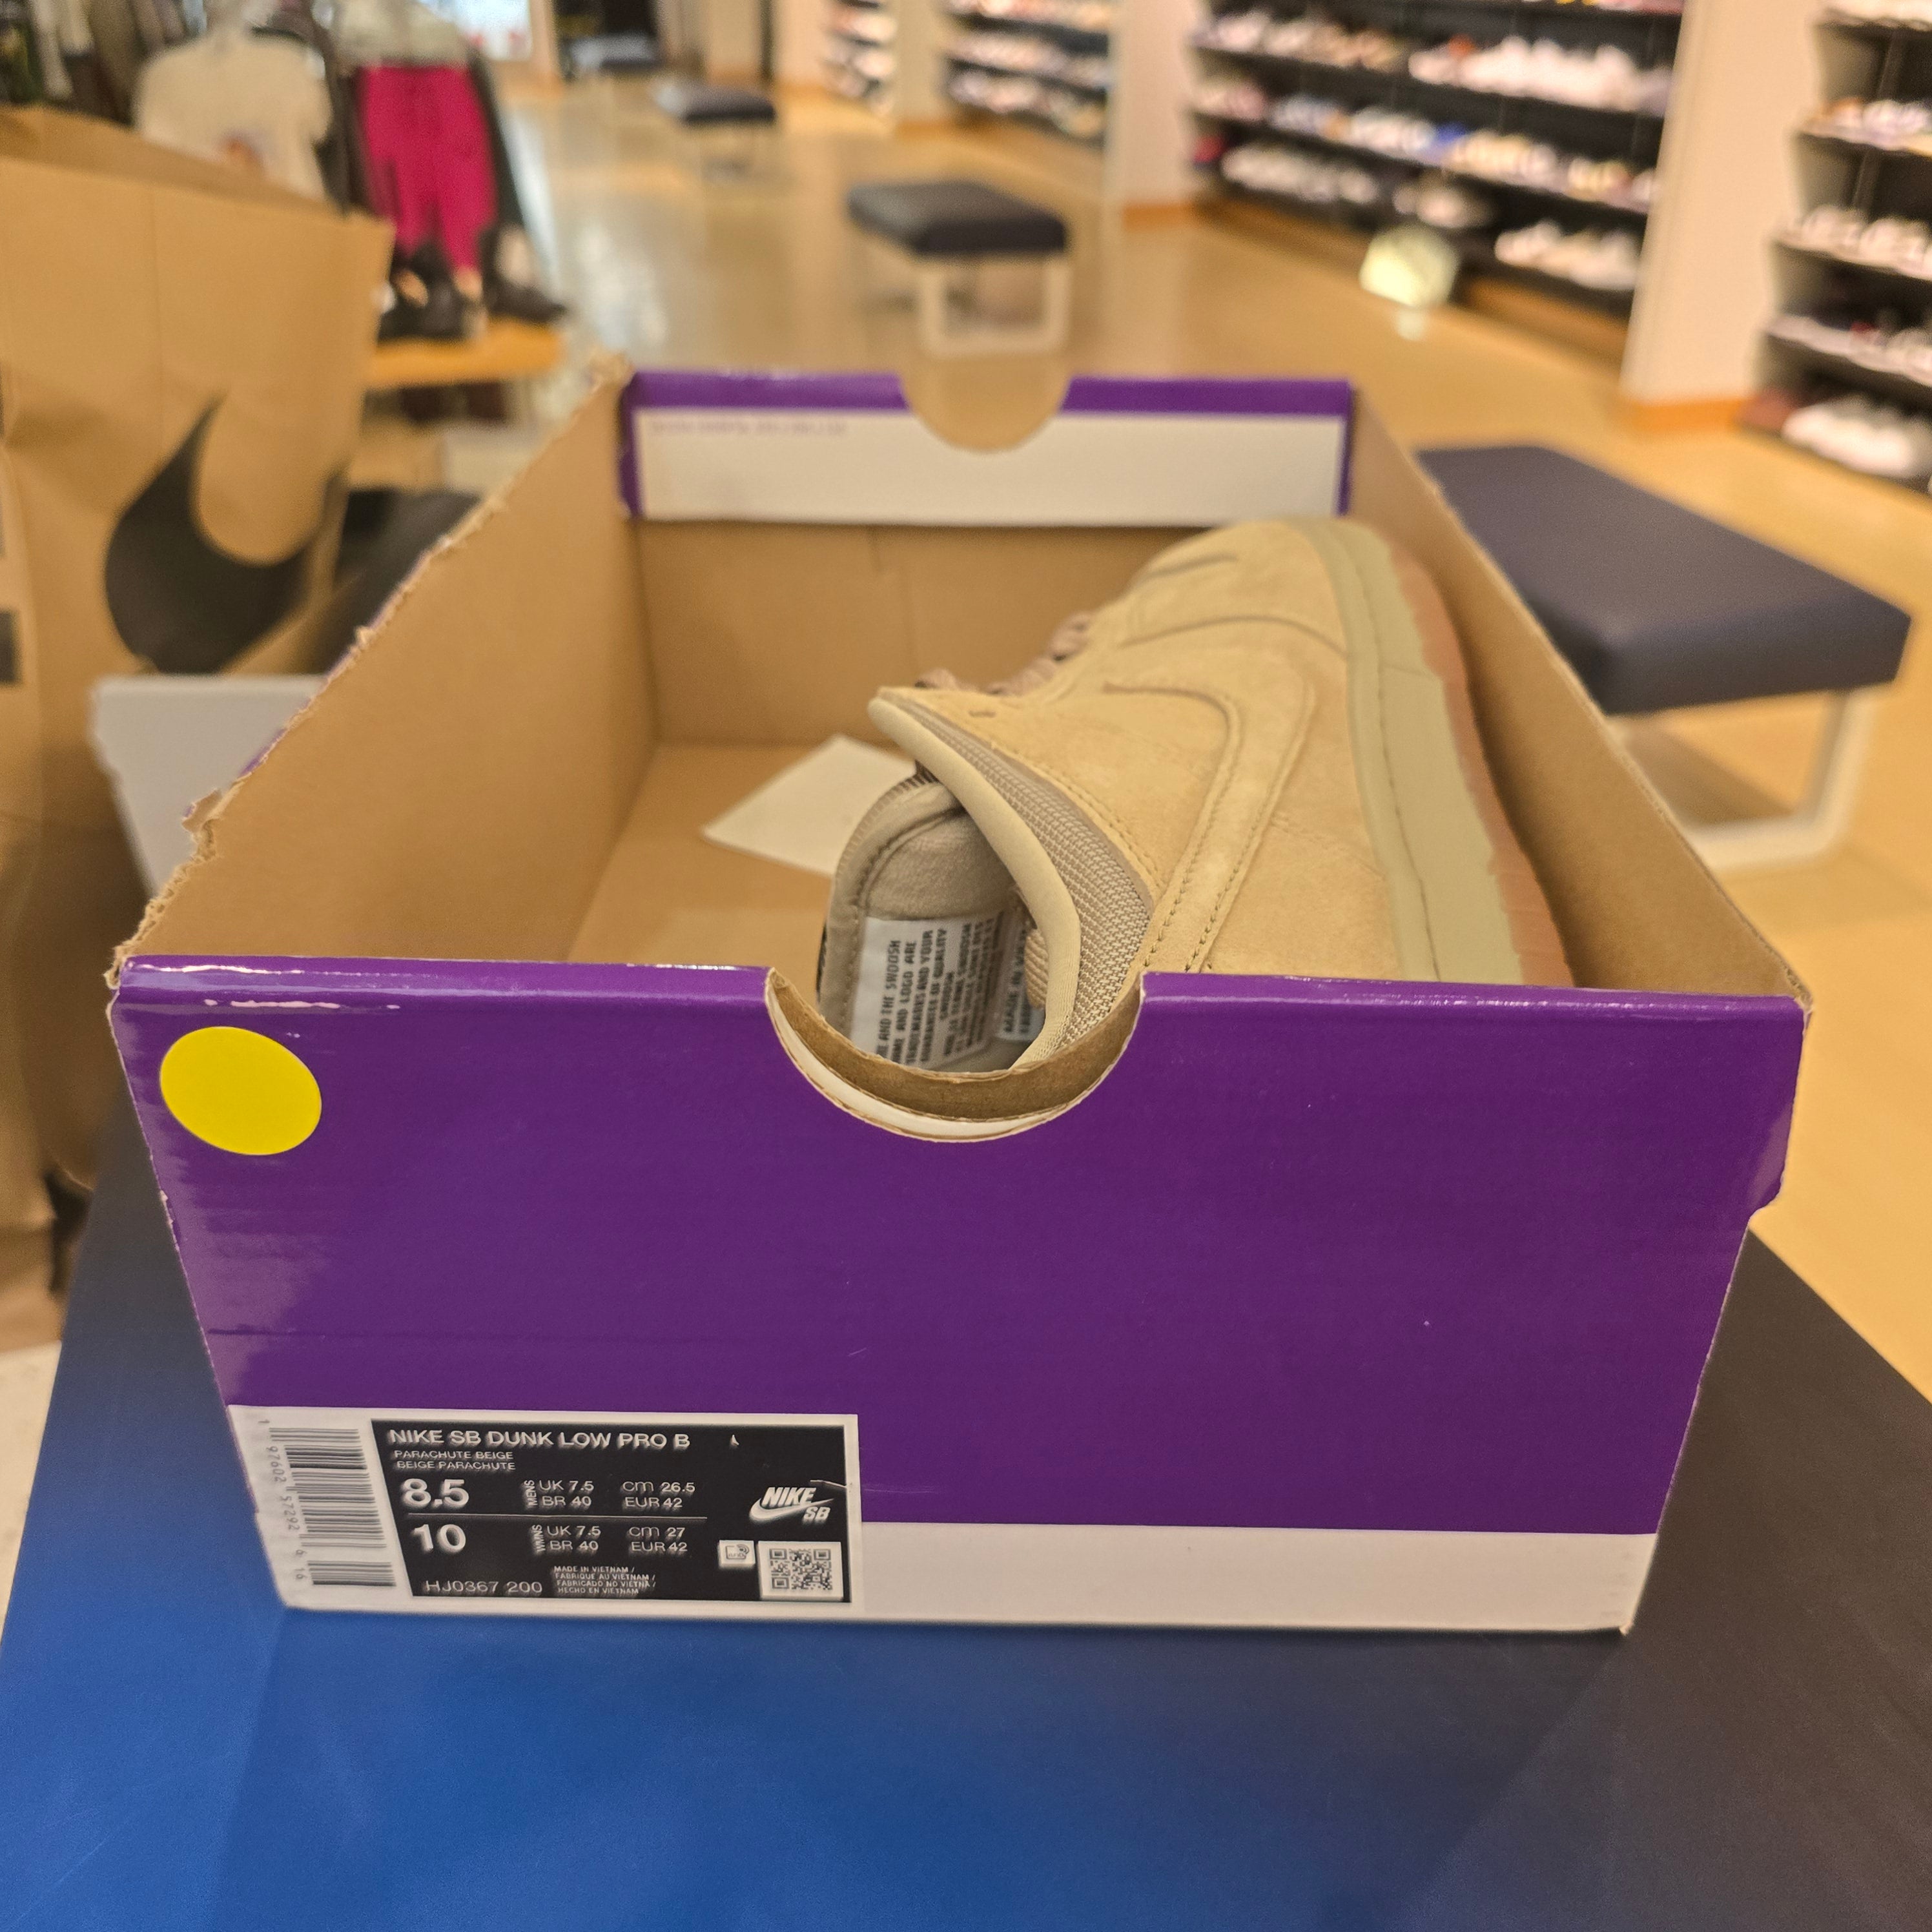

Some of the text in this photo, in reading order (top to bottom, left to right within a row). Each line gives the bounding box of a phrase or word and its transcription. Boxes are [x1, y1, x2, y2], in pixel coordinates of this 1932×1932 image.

[905, 941, 916, 964] ARE
[920, 930, 933, 965] YOUR
[885, 940, 901, 989] SWOOSH
[899, 971, 914, 1003] LOGO
[917, 967, 929, 990] AND
[880, 996, 894, 1014] THE
[879, 1018, 891, 1040] AND
[896, 1009, 908, 1031] AND
[389, 1429, 691, 1448] NIKE SB DUNK LOW PRO B
[393, 1450, 514, 1460] PARACHUTE BEIGE
[396, 1460, 516, 1470] BEIGE PARACHUTE
[265, 1446, 287, 1483] 97602
[279, 1495, 301, 1530] 57292
[403, 1478, 470, 1507] 8.5
[524, 1479, 539, 1506] MENS
[539, 1480, 595, 1492] UK 7.5
[661, 1482, 696, 1493] 26.5
[542, 1495, 592, 1506] BR 40
[624, 1497, 683, 1508] EUR 42
[761, 1486, 817, 1507] NIKE
[803, 1506, 832, 1521] SB
[413, 1524, 467, 1552] 10
[531, 1525, 546, 1552] WMNS
[546, 1525, 602, 1537] UK 7.5
[665, 1527, 686, 1538] 27
[550, 1540, 599, 1551] BR 40
[630, 1541, 688, 1552] EUR 42
[424, 1580, 543, 1594] HJ0367 200
